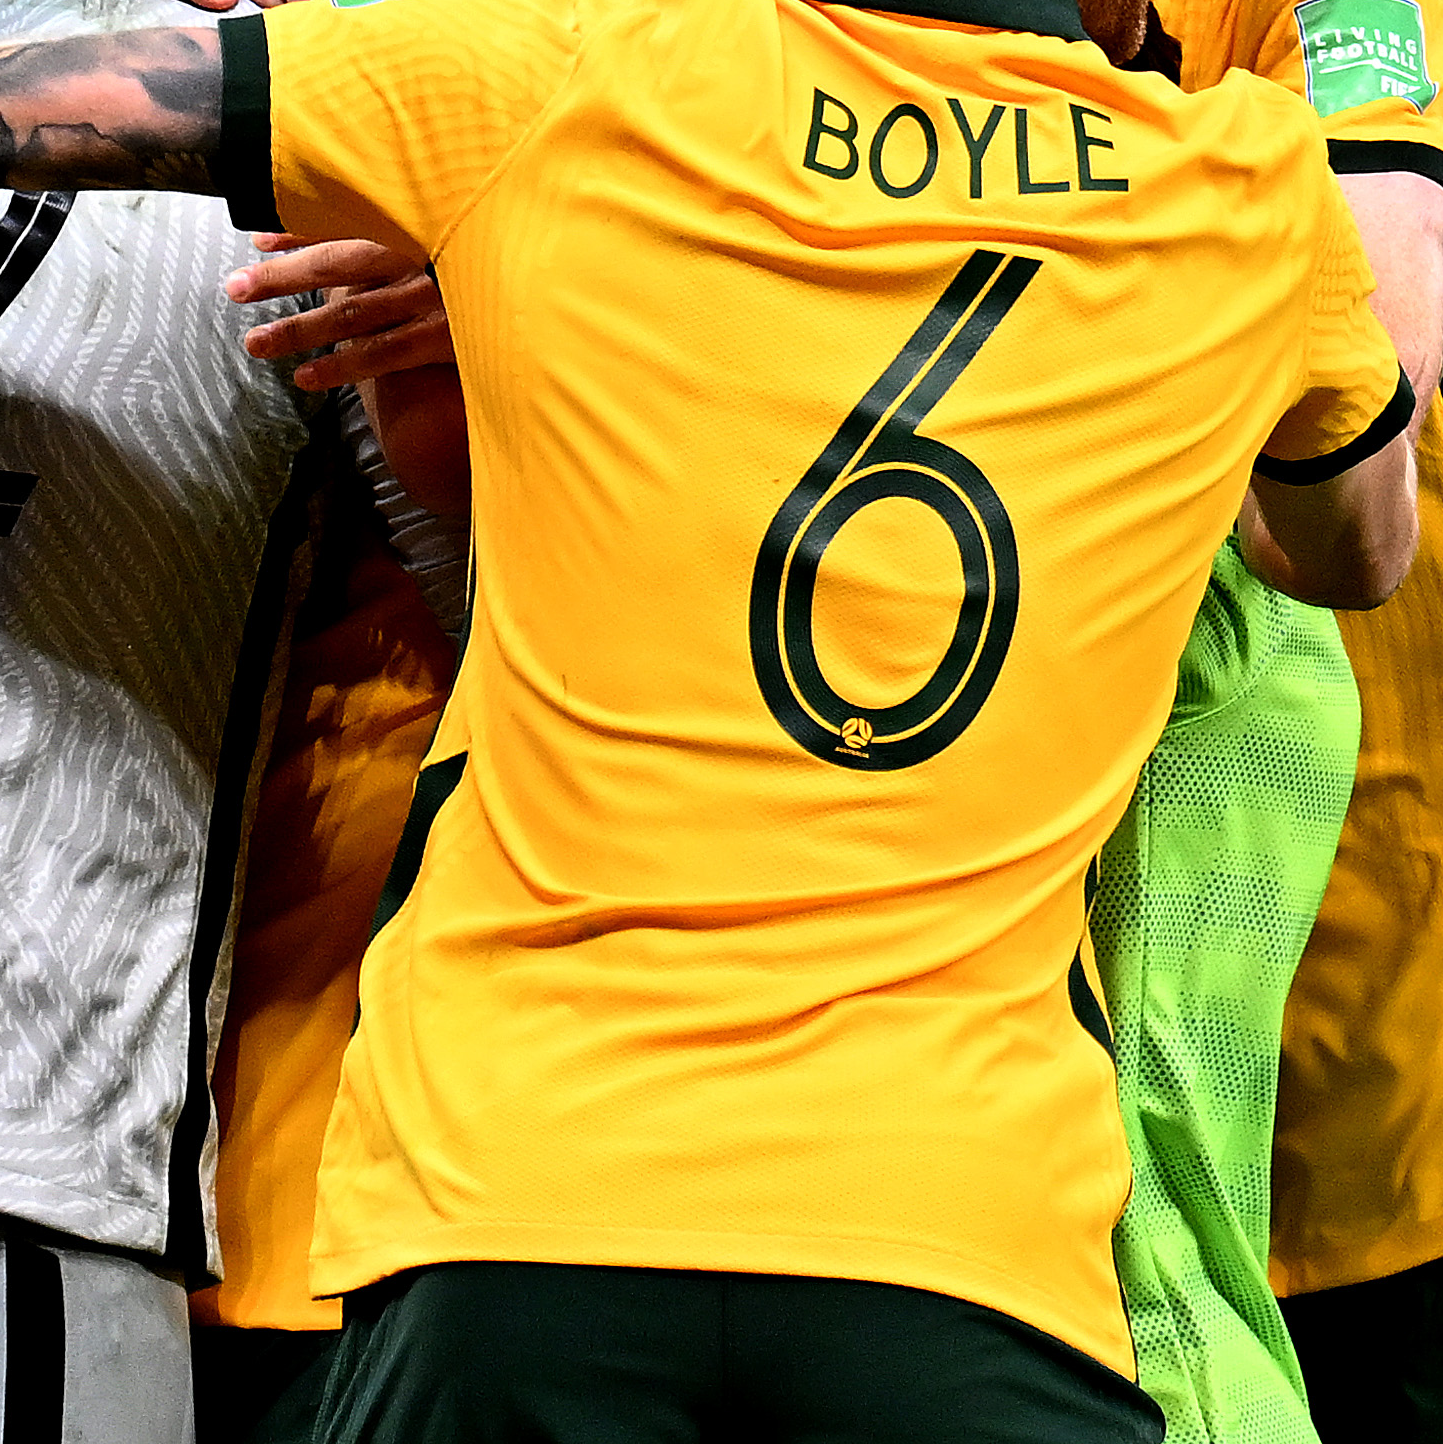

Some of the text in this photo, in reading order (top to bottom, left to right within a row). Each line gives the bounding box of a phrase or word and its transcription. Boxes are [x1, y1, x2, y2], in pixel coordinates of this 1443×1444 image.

[1313, 26, 1418, 55] LIVING
[1317, 40, 1418, 72] FOOTBALL
[802, 87, 1130, 201] BOYLE
[747, 248, 1021, 773] 6
